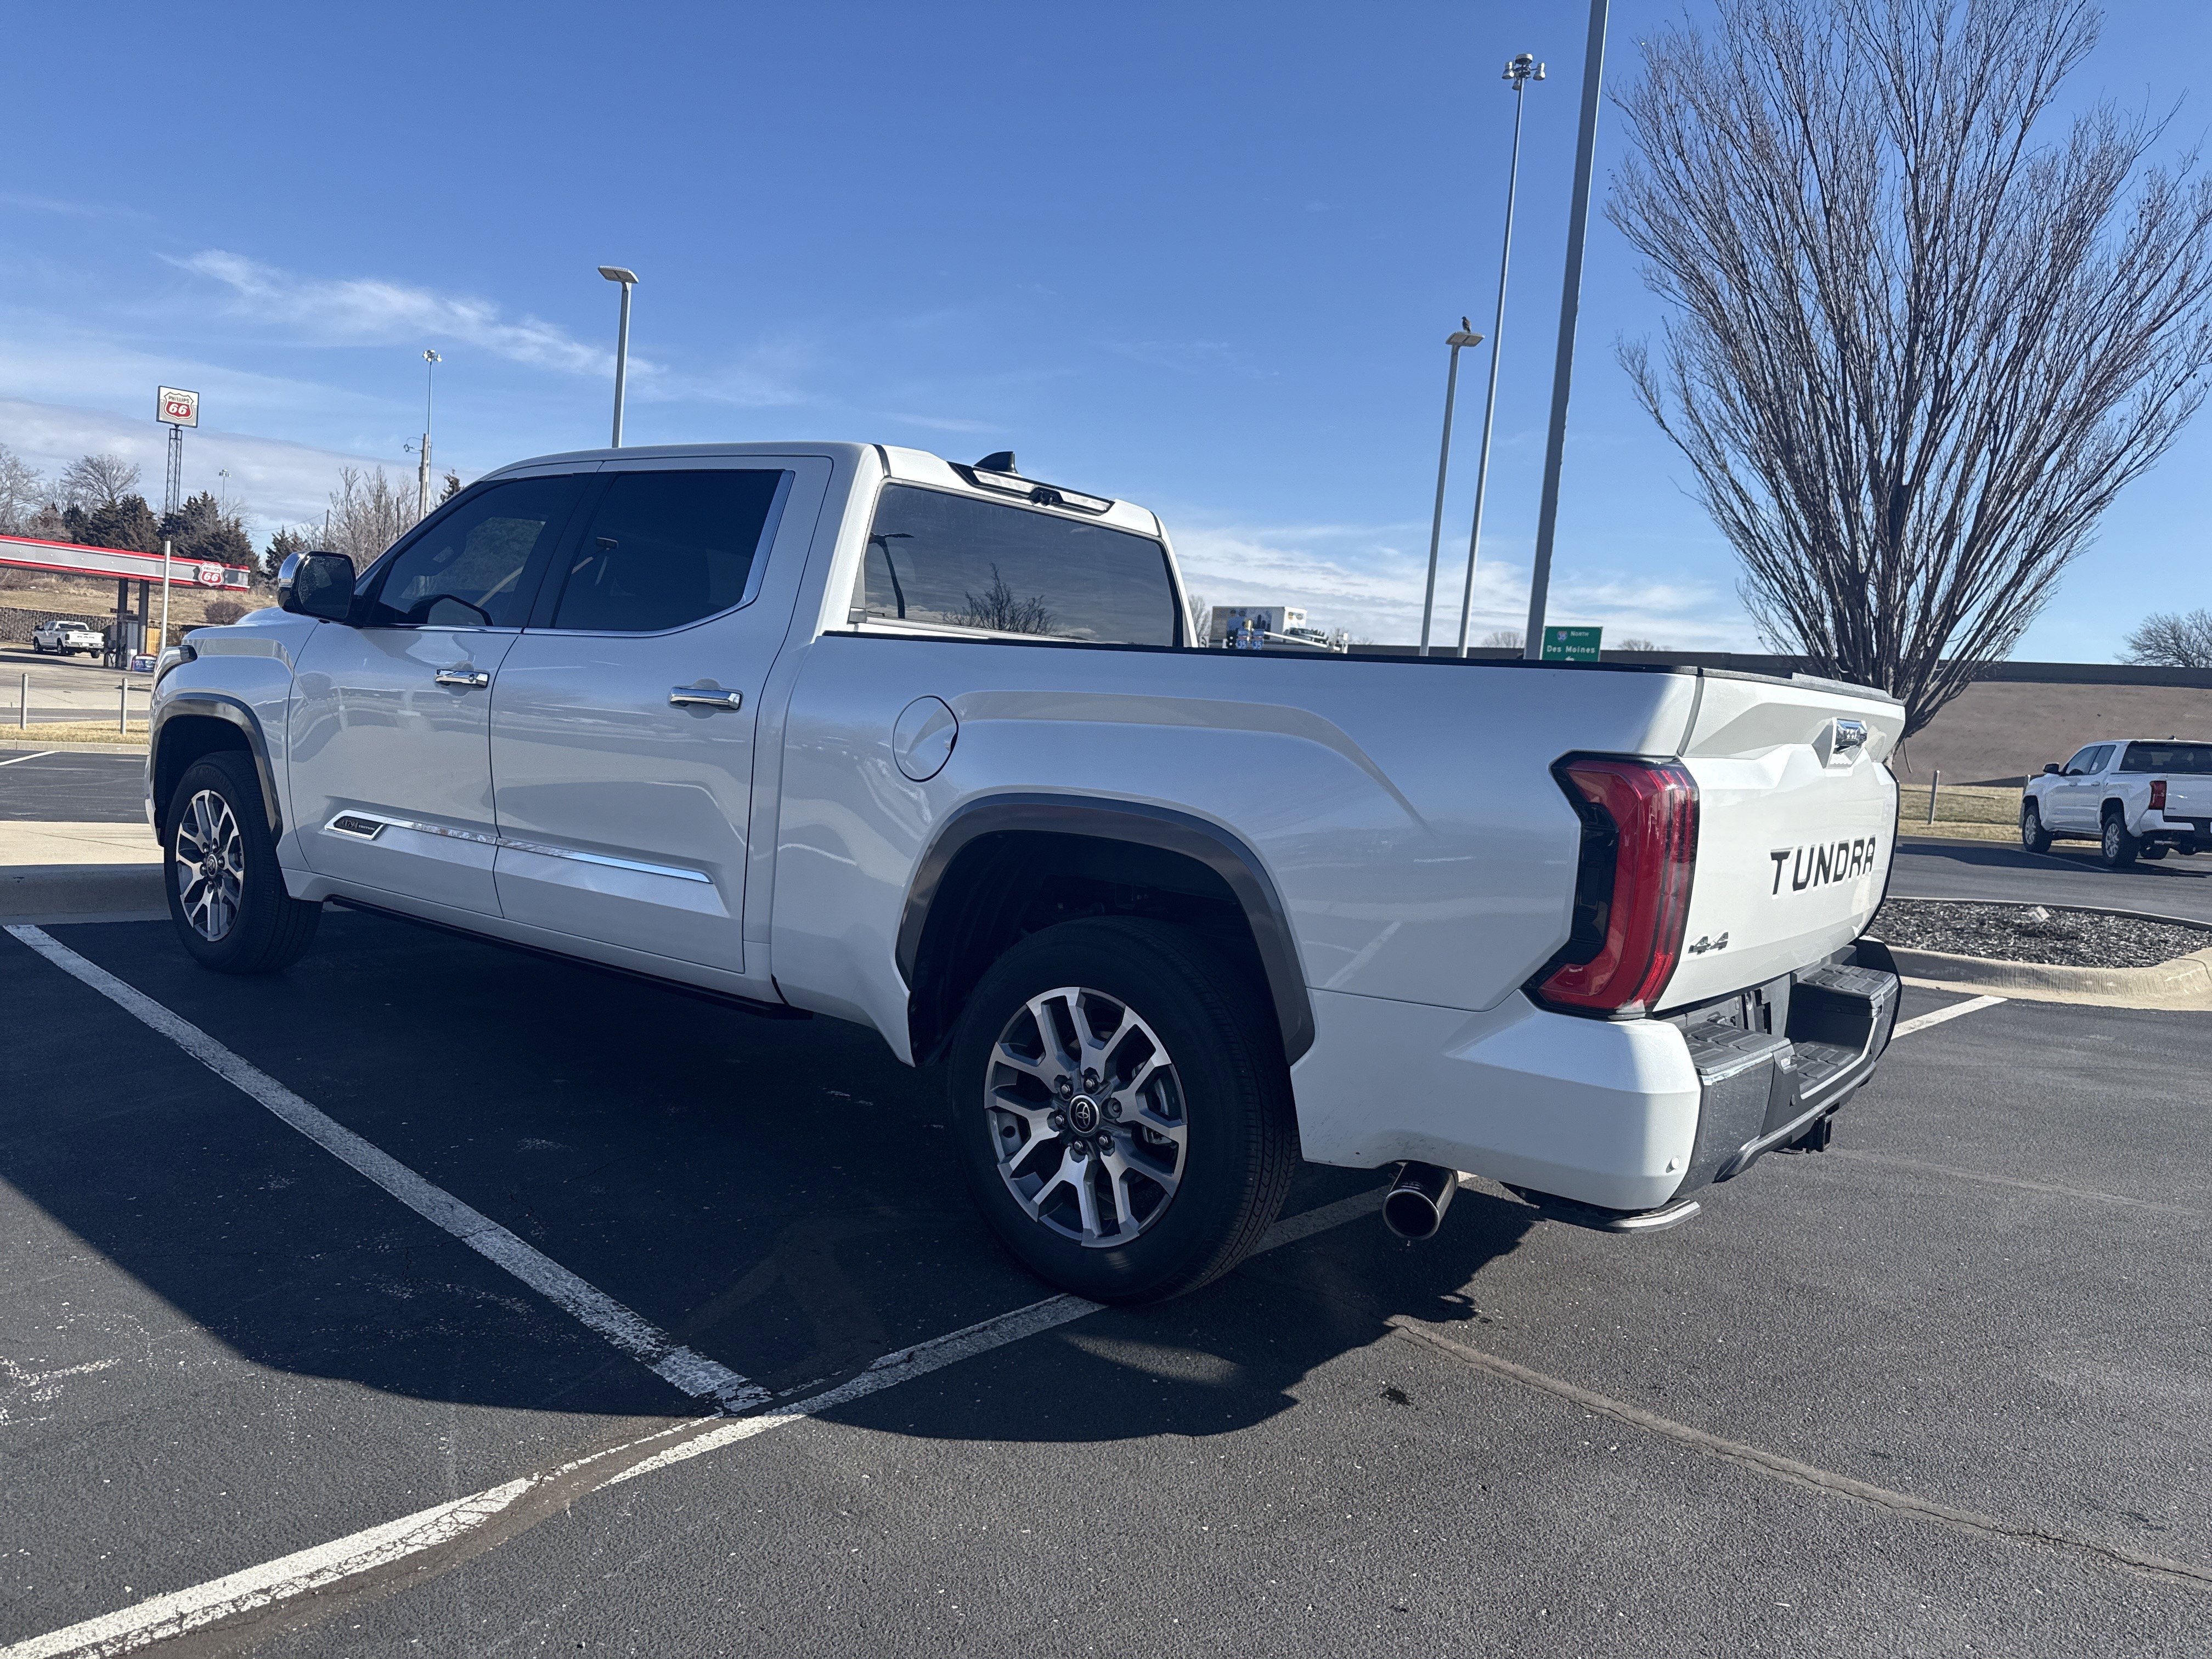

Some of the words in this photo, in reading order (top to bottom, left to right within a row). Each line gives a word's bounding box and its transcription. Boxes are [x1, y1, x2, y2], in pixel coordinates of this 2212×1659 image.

[168, 396, 189, 404] PHILLIPS
[168, 403, 188, 415] 66
[204, 572, 219, 582] 66
[1770, 836, 1876, 896] TUNDRA
